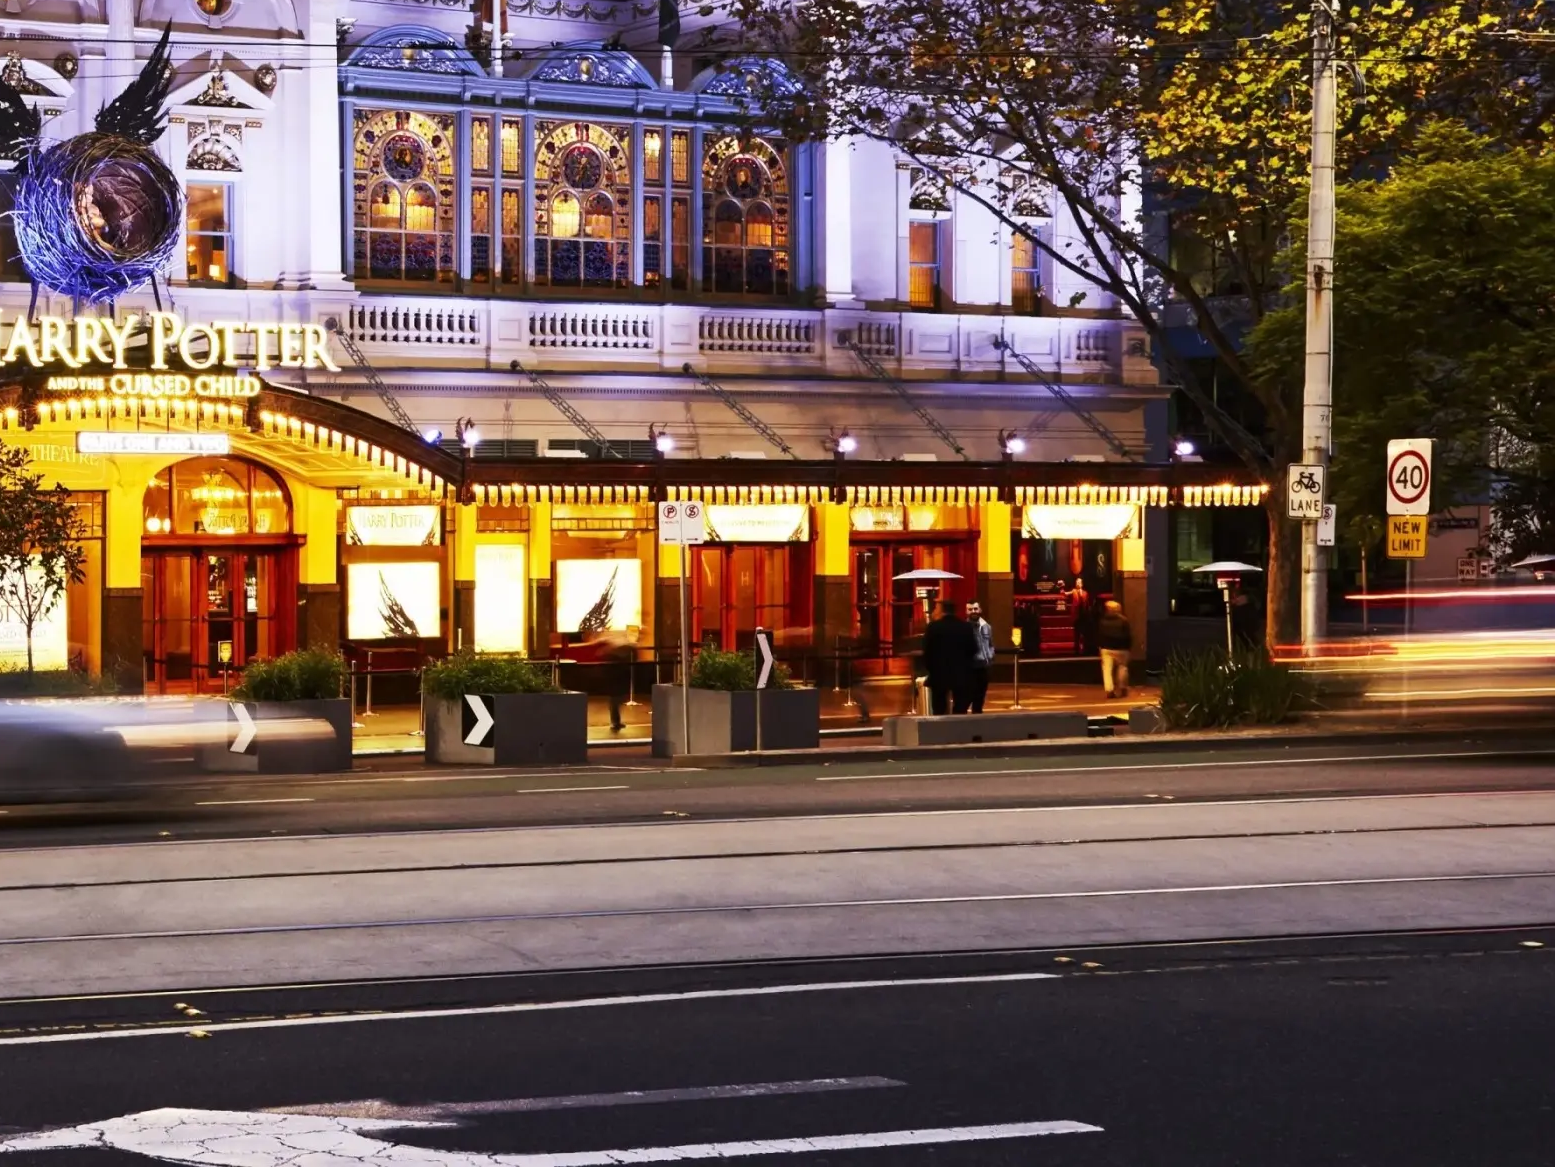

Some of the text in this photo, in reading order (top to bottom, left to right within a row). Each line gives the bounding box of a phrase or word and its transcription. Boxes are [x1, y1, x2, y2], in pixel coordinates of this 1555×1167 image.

[149, 310, 343, 372] POTTER
[110, 374, 191, 397] CURSED
[194, 375, 261, 397] CHILD
[1395, 465, 1423, 490] 40
[1290, 498, 1321, 512] LANE
[358, 511, 425, 529] HARRY POTTER
[1393, 521, 1421, 533] NEW
[1391, 538, 1422, 551] LIMIT
